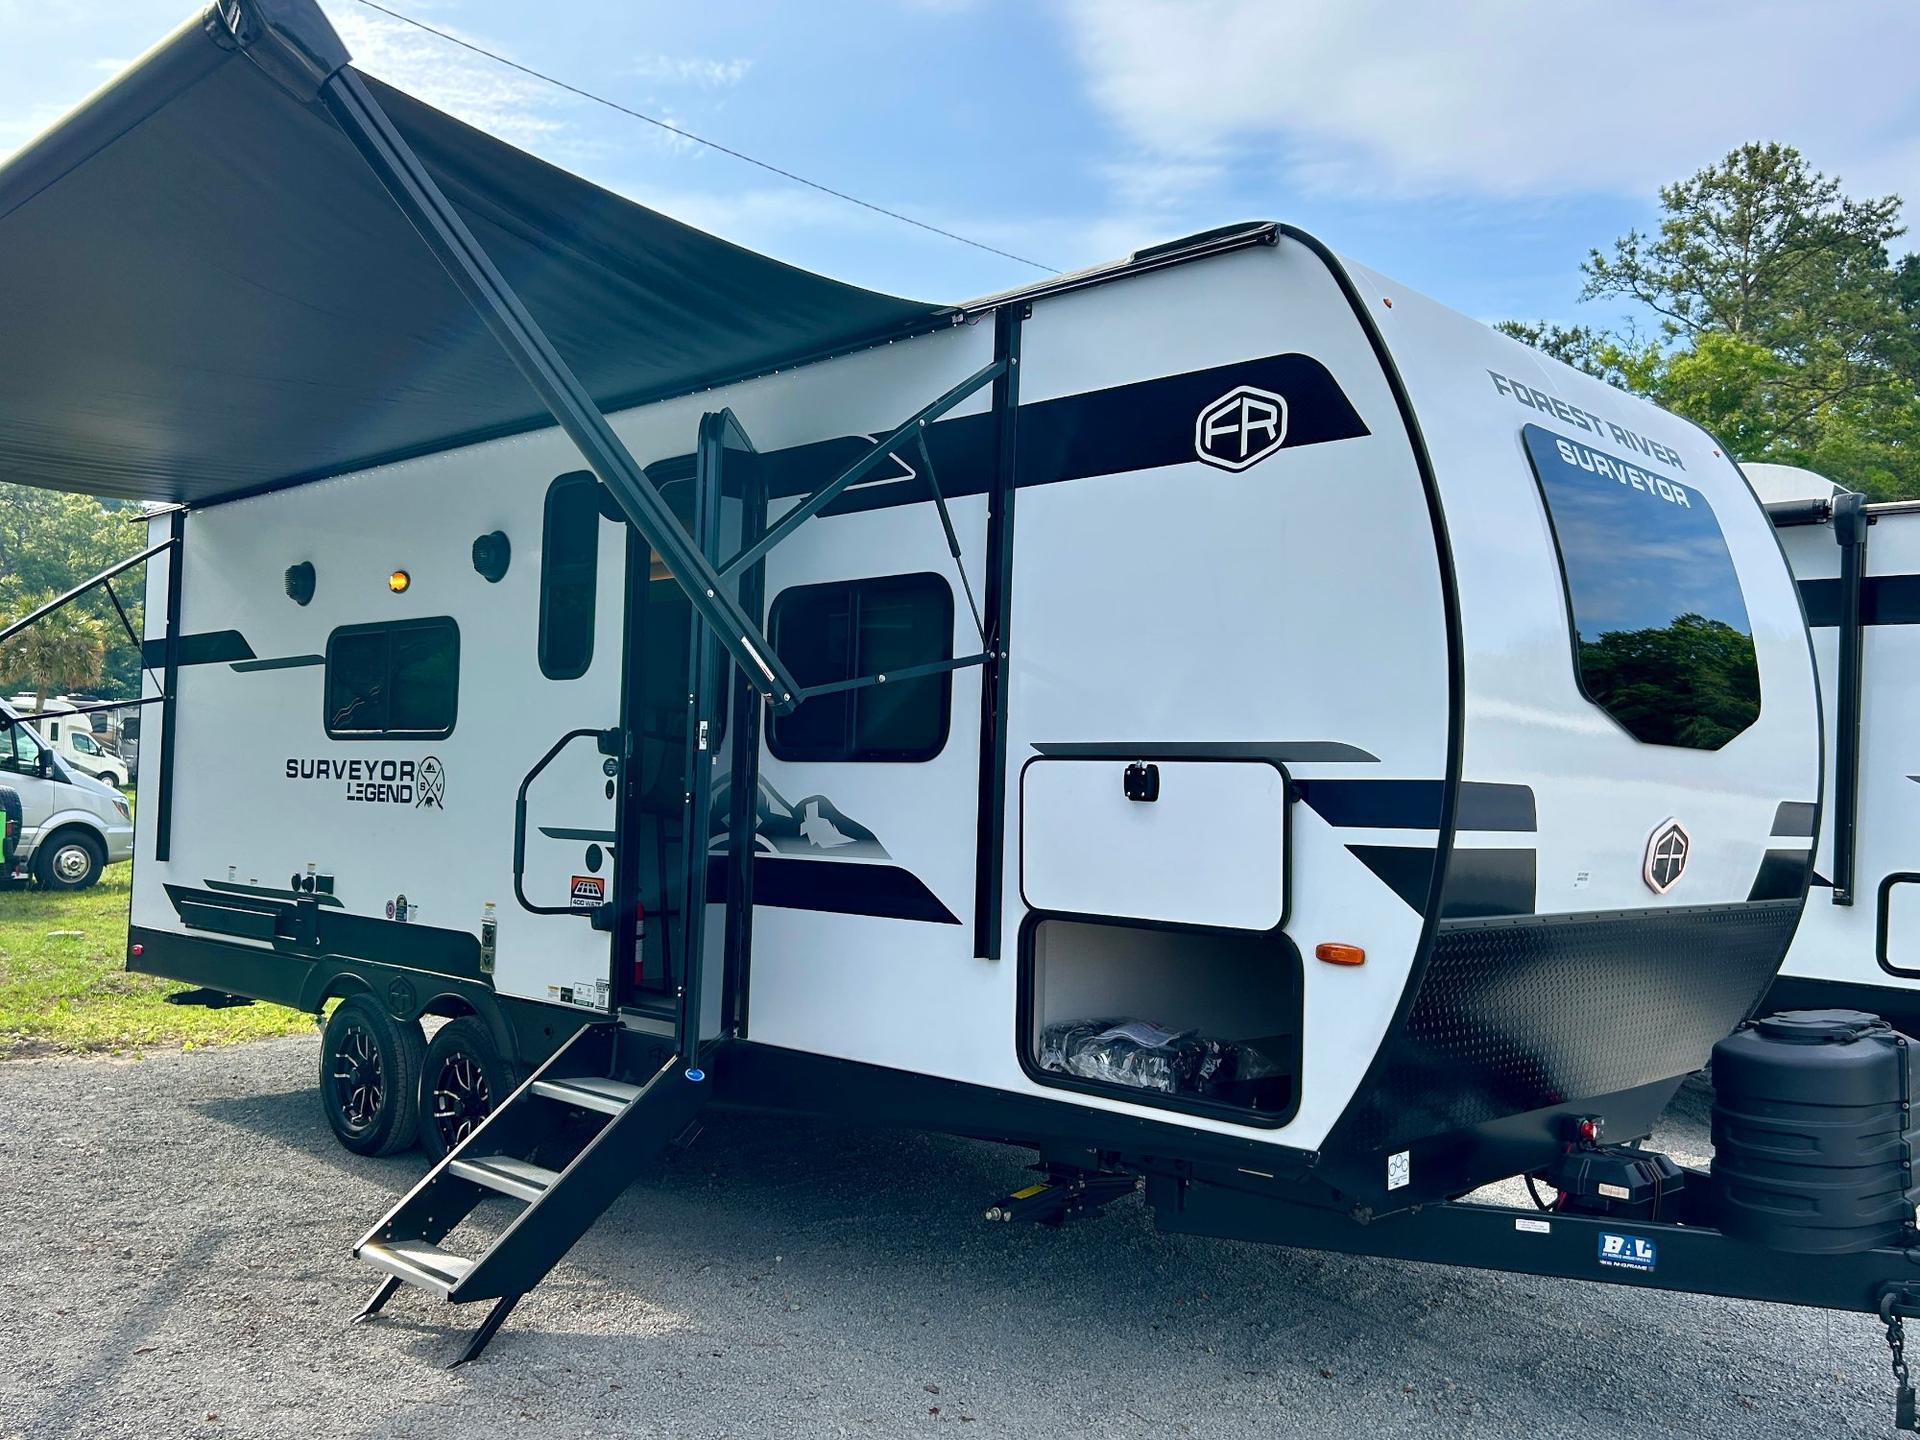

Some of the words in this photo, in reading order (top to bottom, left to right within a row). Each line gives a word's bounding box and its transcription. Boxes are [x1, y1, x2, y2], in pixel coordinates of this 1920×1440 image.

[1487, 368, 1604, 437] FOREST
[1606, 421, 1686, 471] RIVER
[1556, 439, 1691, 509] SURVEYOR
[285, 758, 416, 782] SURVEYOR
[346, 782, 413, 804] LEGEND
[1603, 1235, 1653, 1258] BAL
